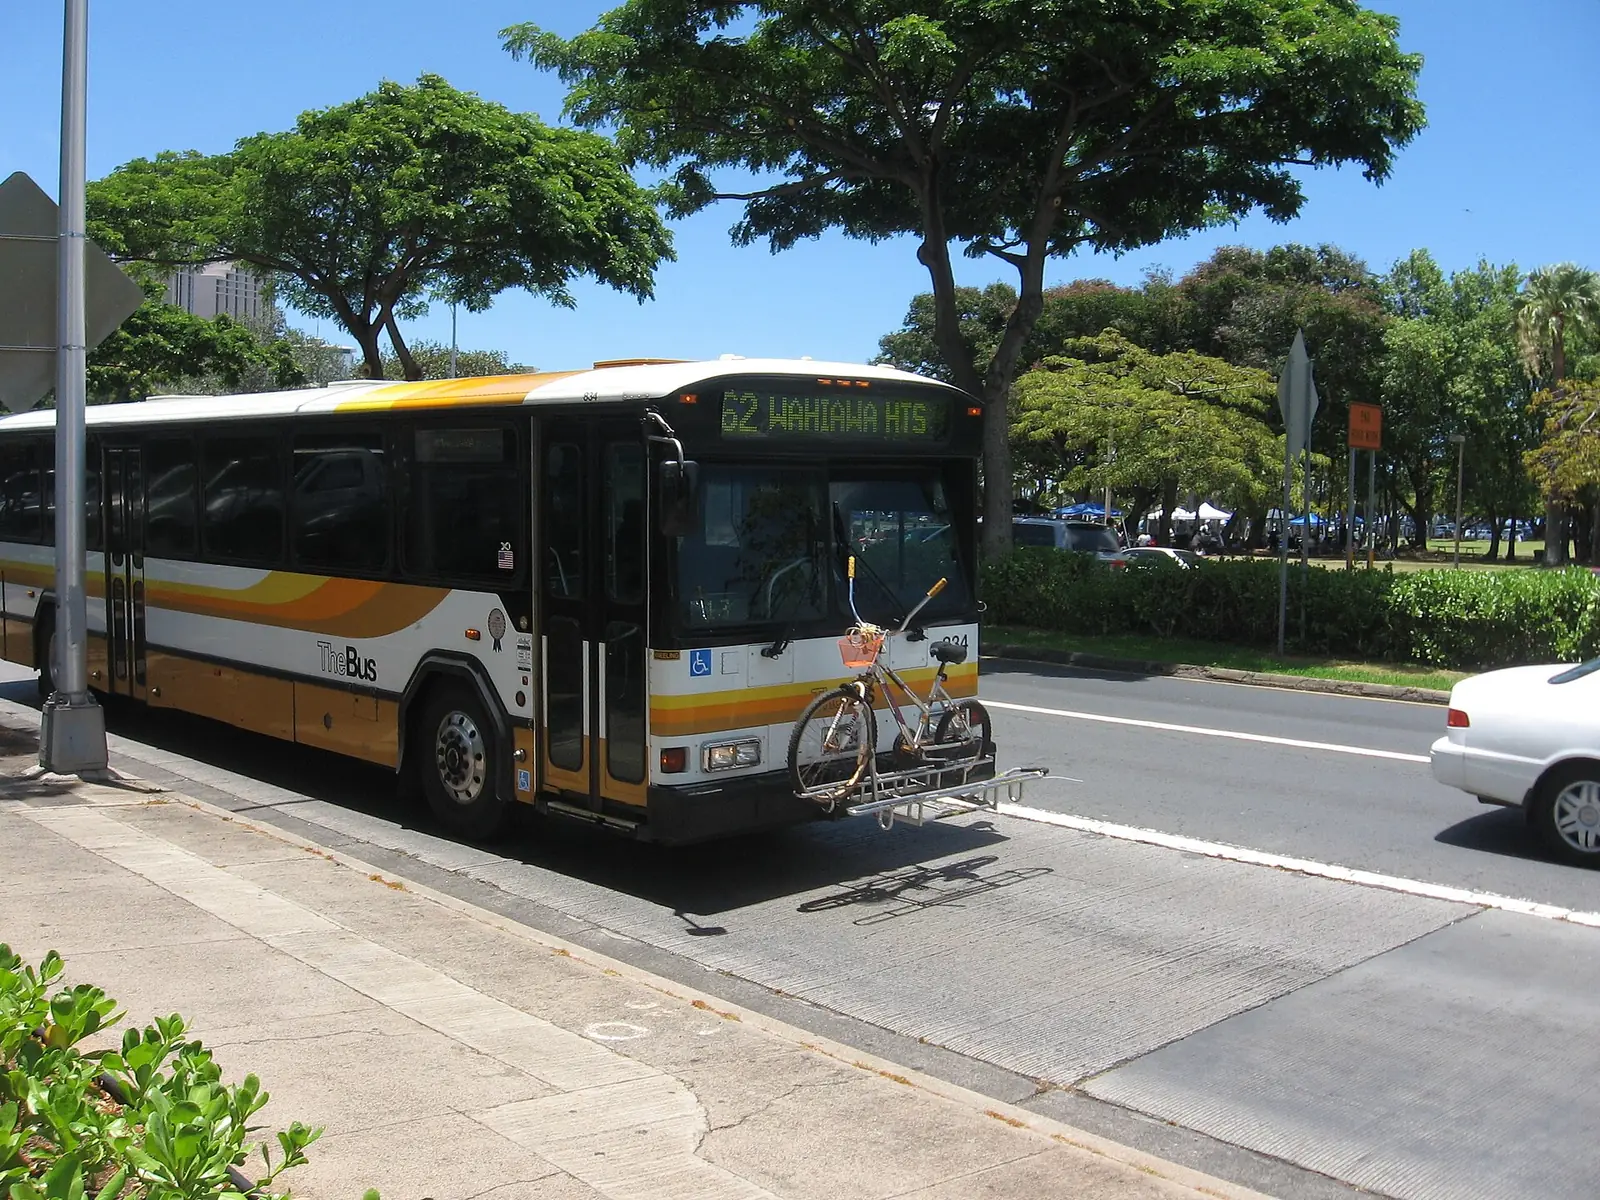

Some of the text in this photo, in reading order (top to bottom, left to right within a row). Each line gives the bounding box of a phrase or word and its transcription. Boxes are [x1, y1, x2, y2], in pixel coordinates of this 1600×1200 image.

[583, 392, 598, 401] 834
[721, 390, 928, 434] 62 WAHIAWA HTS
[317, 640, 377, 682] TheBus
